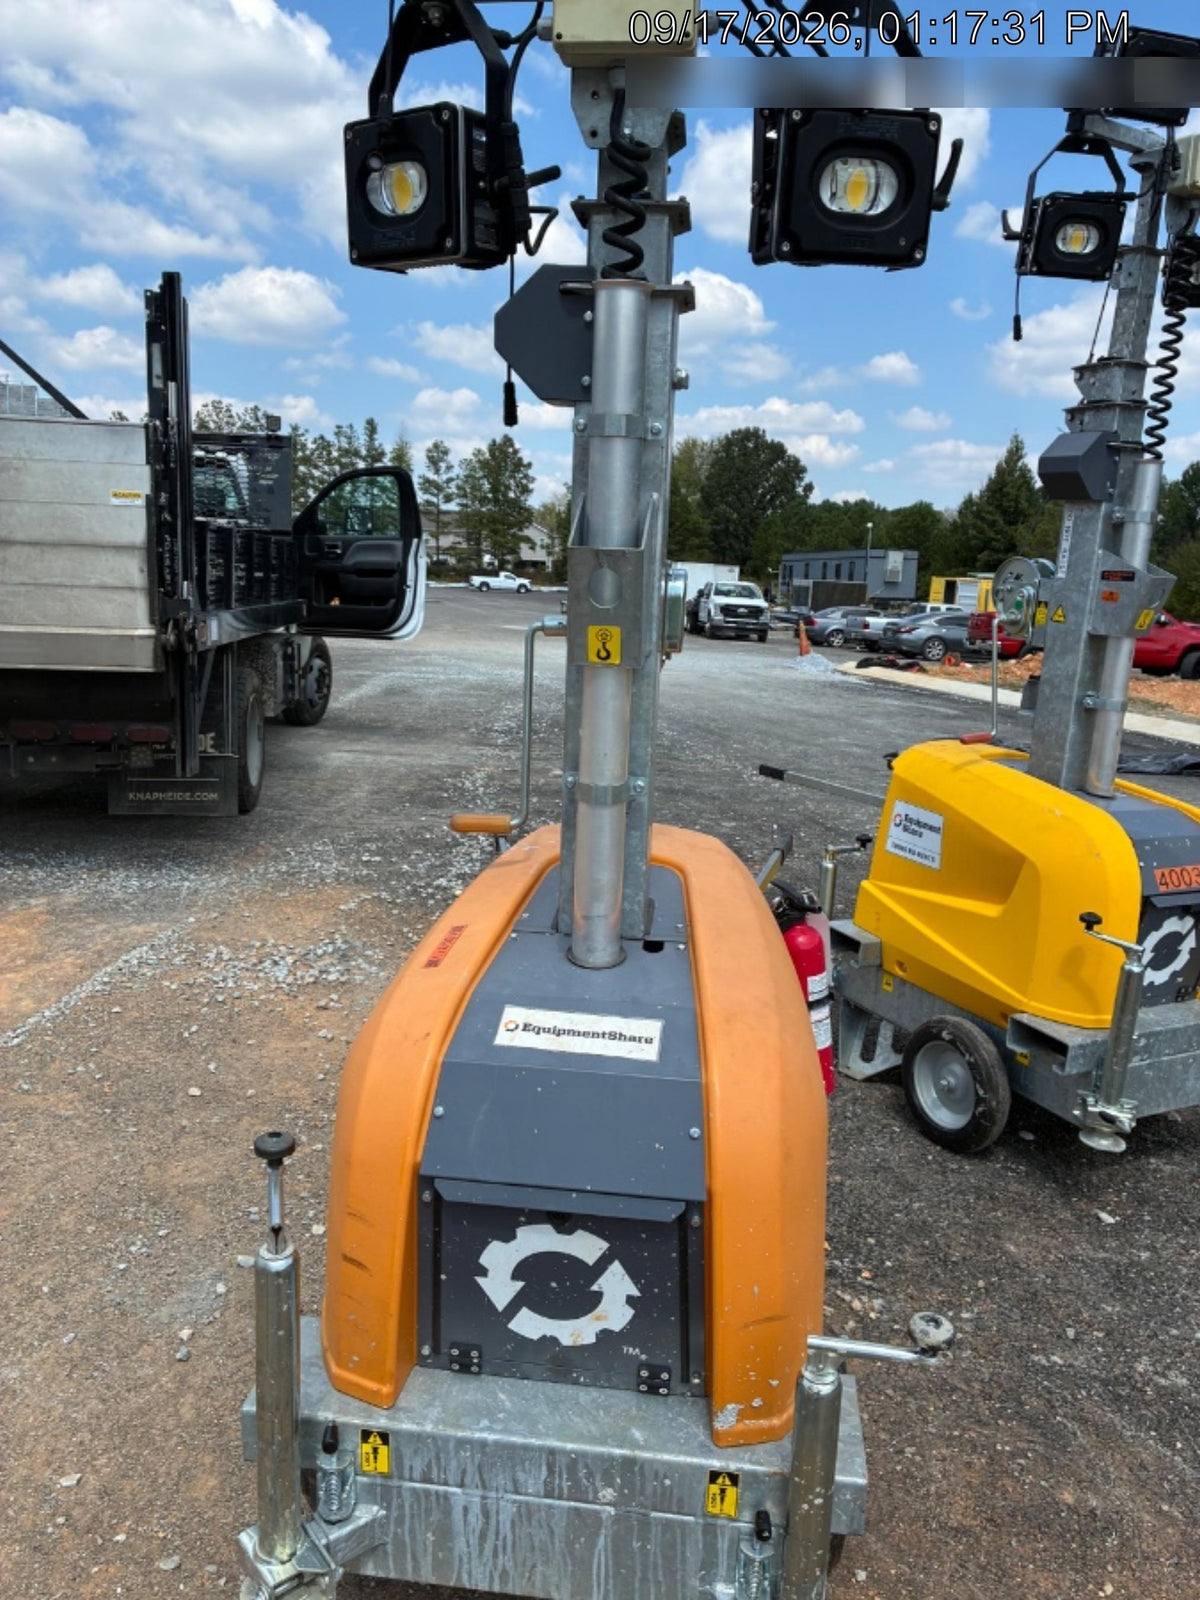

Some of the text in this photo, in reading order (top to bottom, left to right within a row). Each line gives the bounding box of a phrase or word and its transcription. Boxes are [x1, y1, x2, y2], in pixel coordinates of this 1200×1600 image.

[128, 792, 219, 801] KNAPHEIDE.COM
[904, 813, 942, 835] Equipment
[521, 1022, 655, 1045] EquipmentShare
